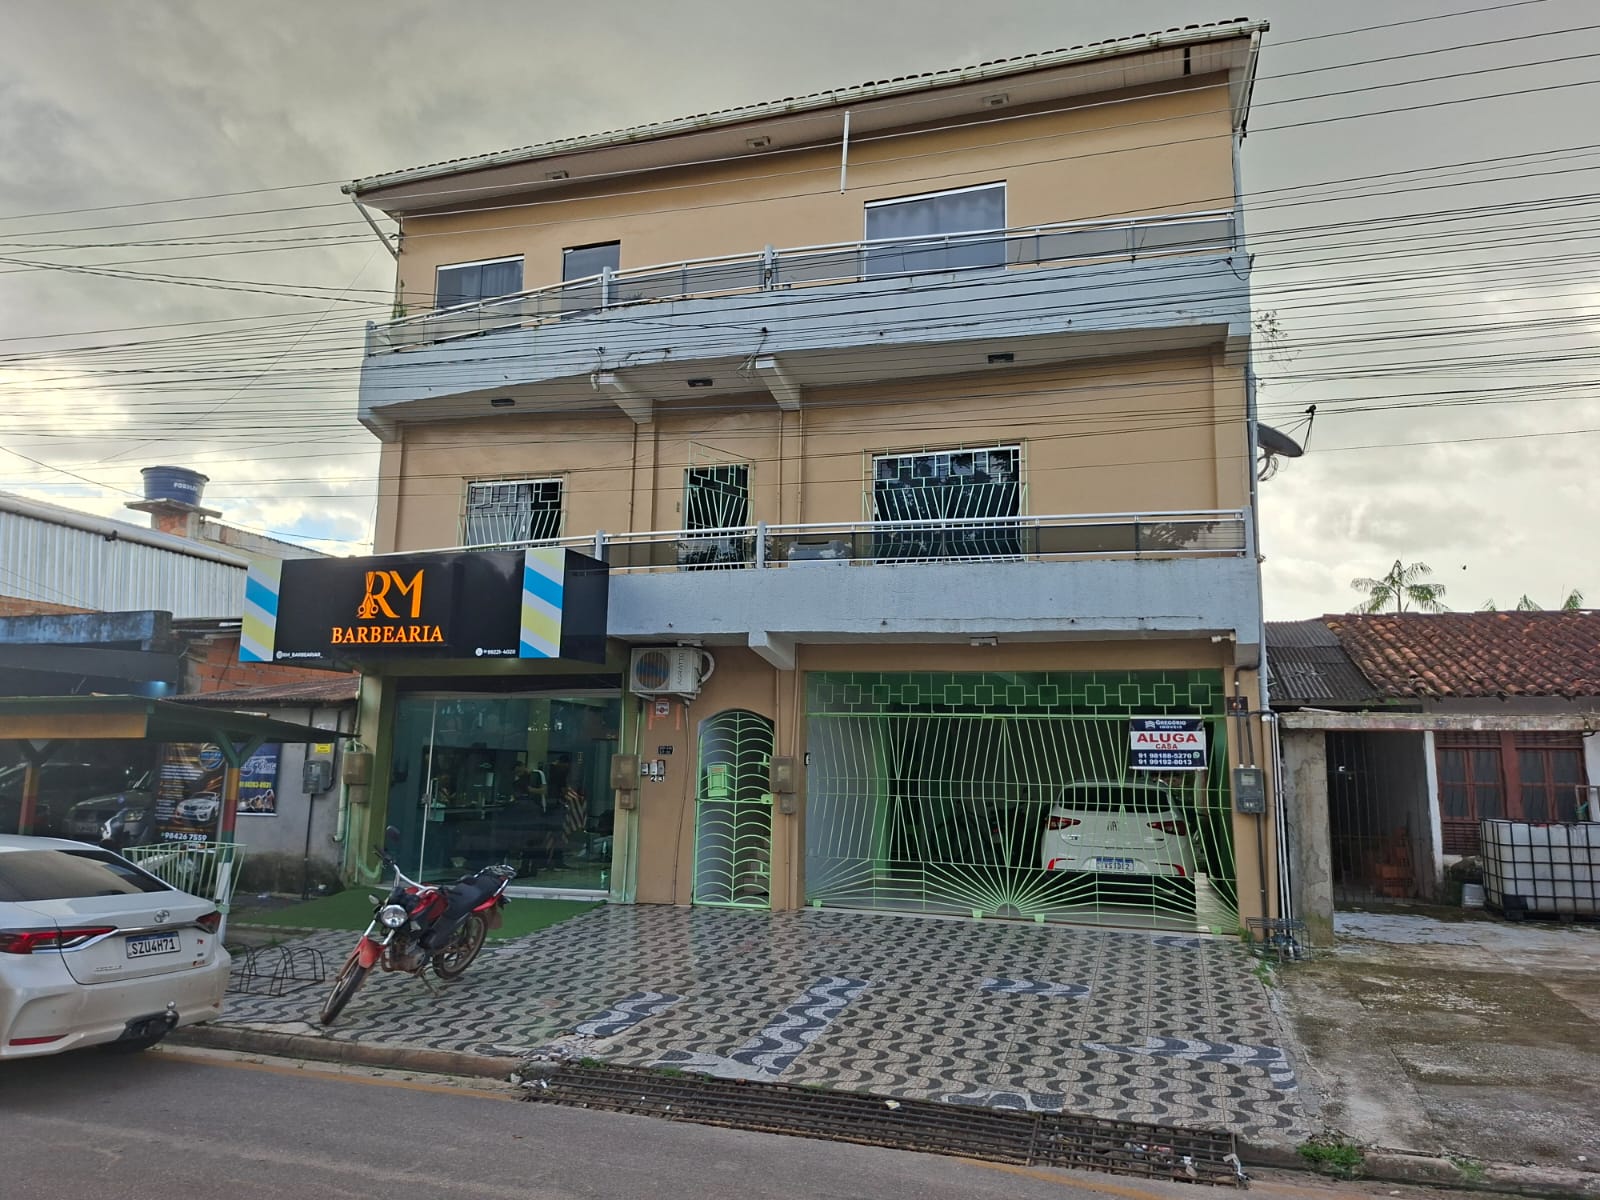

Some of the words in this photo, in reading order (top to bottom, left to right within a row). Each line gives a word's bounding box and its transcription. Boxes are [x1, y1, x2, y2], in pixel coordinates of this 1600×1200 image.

[356, 569, 424, 619] RM
[331, 625, 444, 644] BARBEARIA
[1137, 733, 1197, 742] ALUGA
[130, 938, 176, 955] SZU4H71
